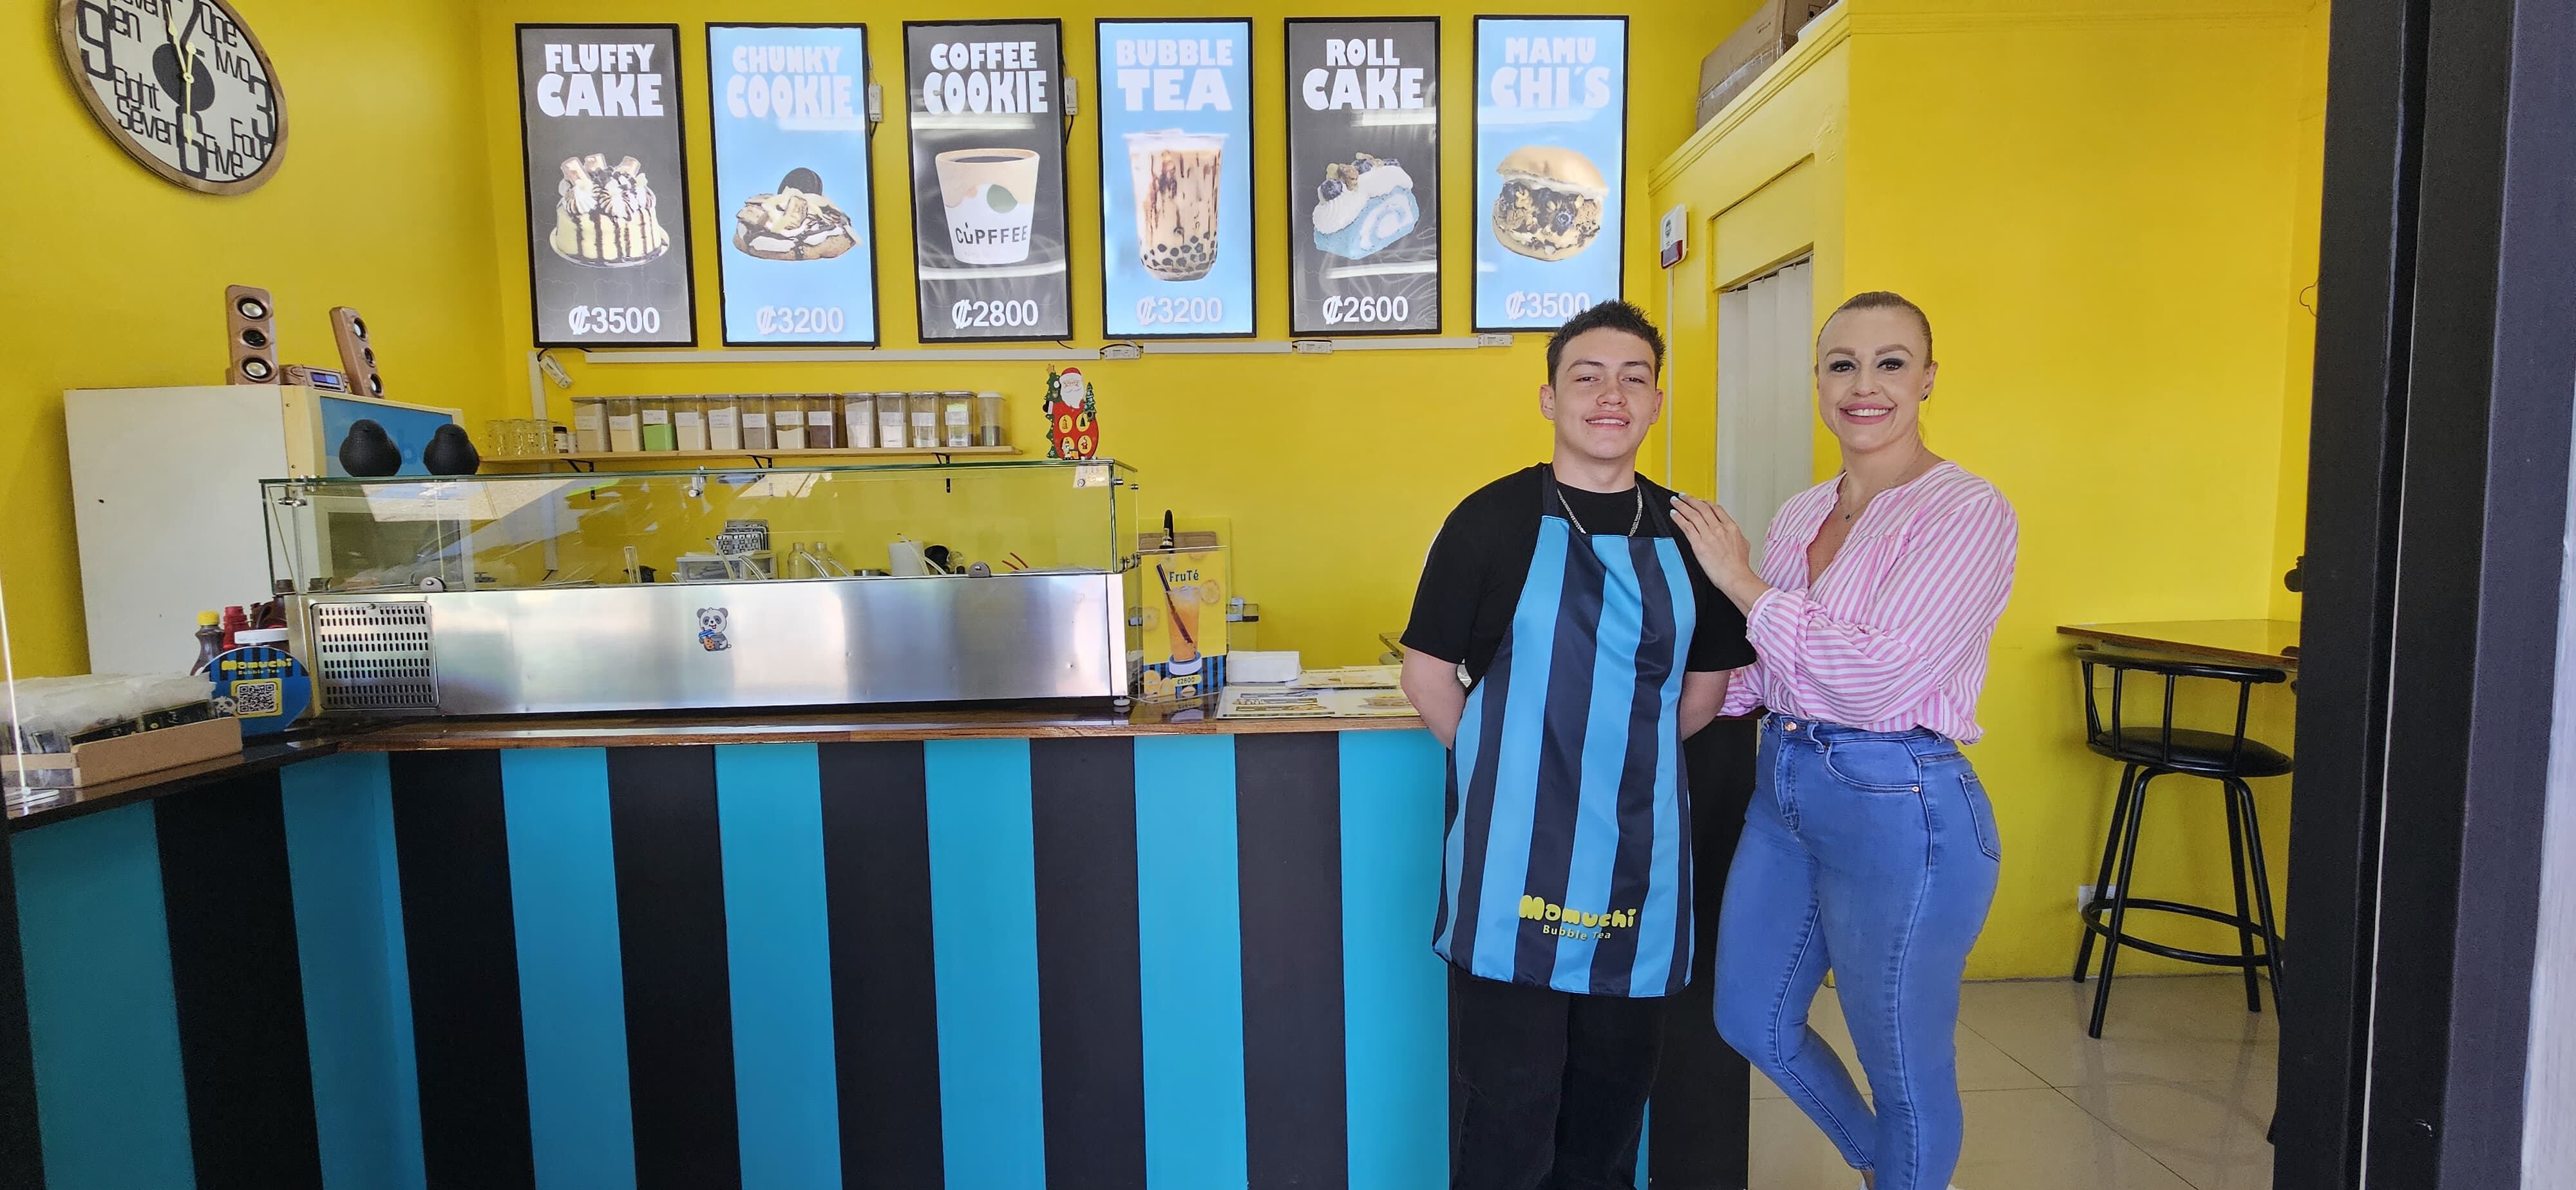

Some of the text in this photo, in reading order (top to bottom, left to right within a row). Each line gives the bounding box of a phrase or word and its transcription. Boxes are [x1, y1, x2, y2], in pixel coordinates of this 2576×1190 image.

[77, 0, 115, 81] 9
[931, 42, 1037, 70] COFFEE
[1116, 39, 1233, 66] BUBBLE
[1326, 39, 1400, 66] ROLL
[1505, 37, 1596, 64] MAMU
[544, 44, 655, 72] FLUFFY
[732, 46, 842, 73] CHUNKY
[537, 73, 664, 117] CAKE
[726, 75, 853, 119] COOKIE
[923, 70, 1048, 115] COOKIE
[1117, 69, 1233, 111] TEA
[1302, 68, 1424, 110] CAKE
[249, 75, 275, 144] 3
[1169, 569, 1199, 582] FruTé
[1519, 894, 1636, 928] Mamuchi
[1543, 925, 1587, 940] Bubble
